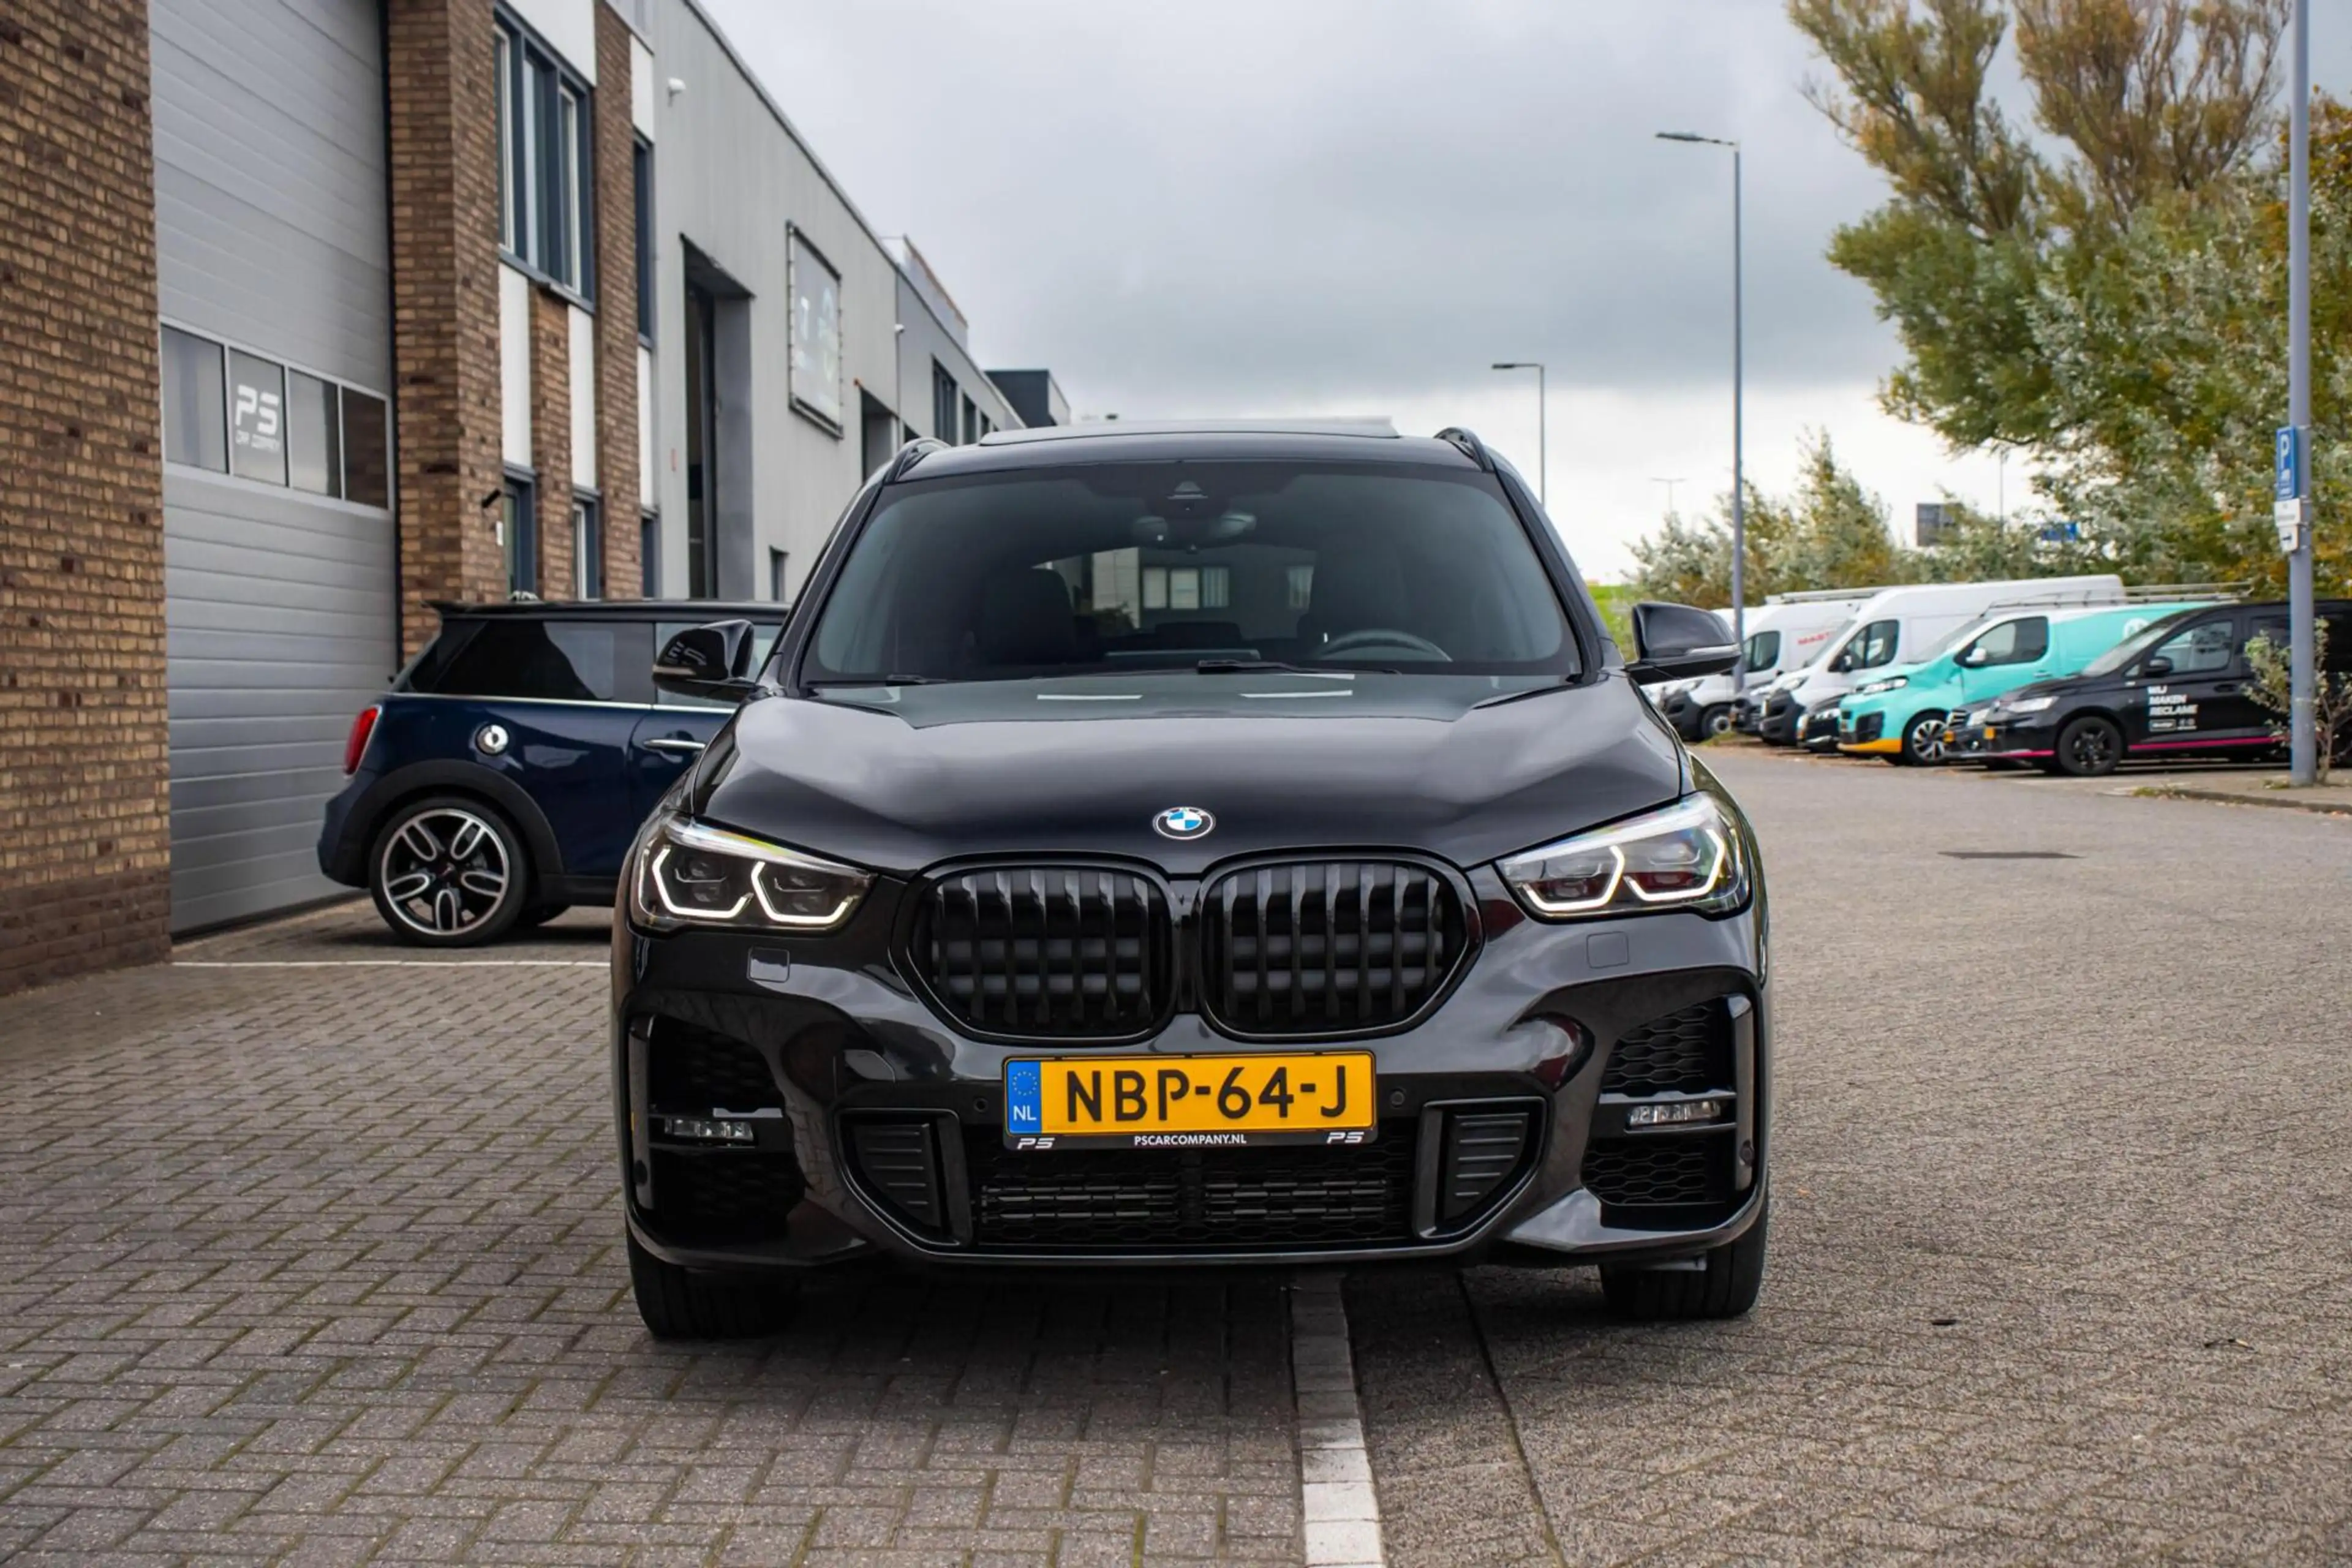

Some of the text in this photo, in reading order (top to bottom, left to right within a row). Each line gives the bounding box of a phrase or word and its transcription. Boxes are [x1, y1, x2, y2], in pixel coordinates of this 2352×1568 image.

[235, 383, 279, 435] PS
[2280, 434, 2290, 470] P
[2149, 704, 2199, 716] RECLAME
[1066, 1065, 1346, 1122] NBP-64-J
[1013, 1105, 1036, 1121] NL
[1017, 1137, 1055, 1150] PS
[1134, 1134, 1247, 1146] PSCARCOMPANY.NL
[1326, 1131, 1365, 1144] PS
